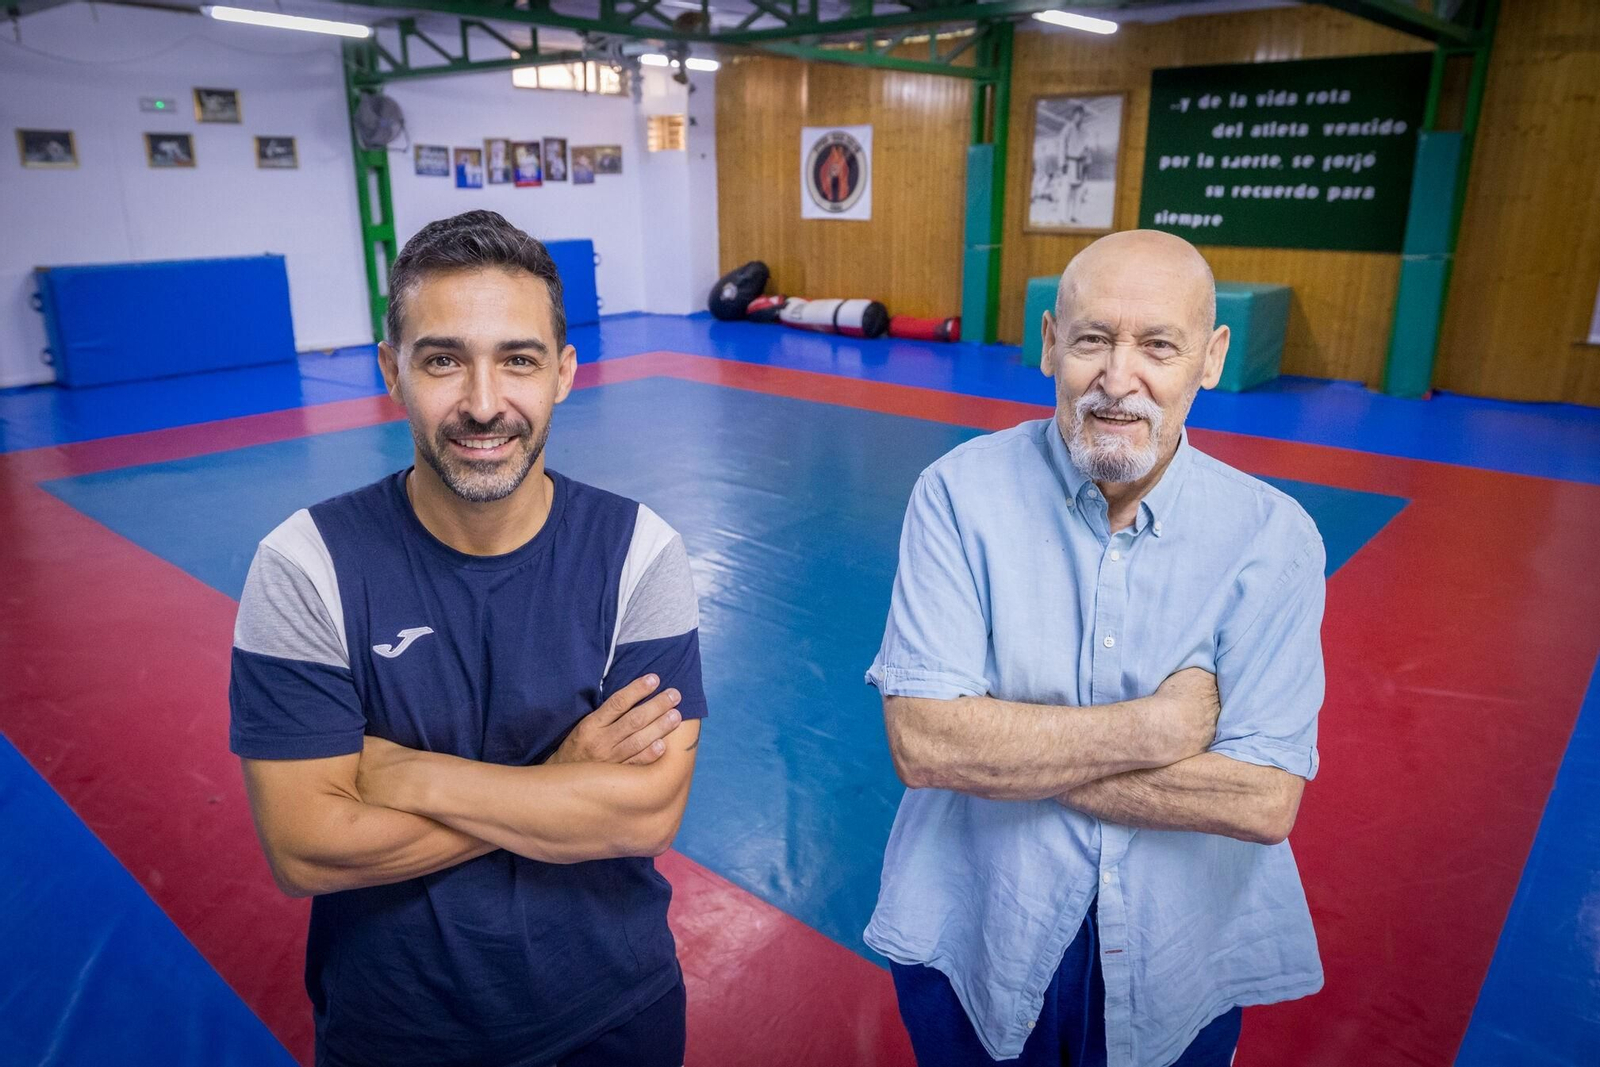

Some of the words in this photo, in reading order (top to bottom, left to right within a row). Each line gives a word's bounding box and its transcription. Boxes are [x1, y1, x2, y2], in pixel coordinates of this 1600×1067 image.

[1198, 93, 1222, 110] de
[1229, 91, 1248, 109] la
[1256, 89, 1299, 107] vida
[1306, 88, 1351, 106] rota
[1211, 122, 1244, 139] del
[1250, 121, 1309, 138] atleta
[1323, 117, 1408, 136] vencido
[1159, 155, 1191, 171] por
[1196, 152, 1214, 169] la
[1292, 154, 1315, 169] se
[1205, 185, 1225, 198] su
[1231, 183, 1320, 199] recuerdo
[1326, 186, 1376, 202] para
[1154, 209, 1223, 229] siempre
